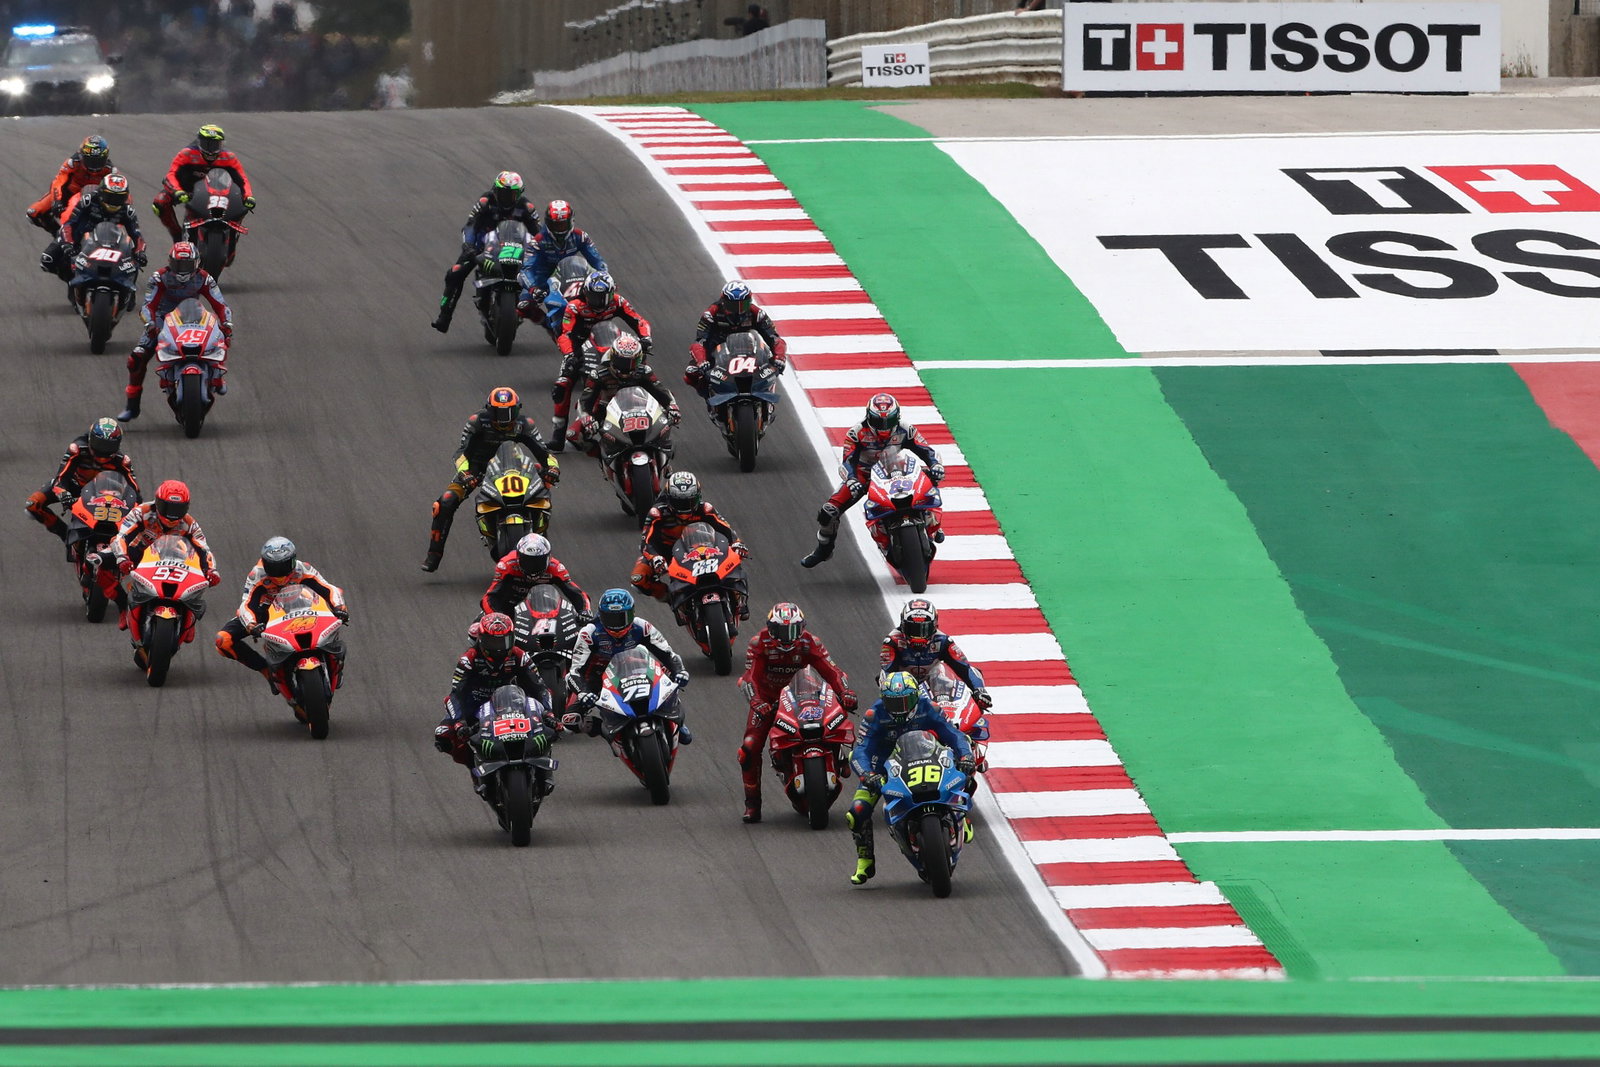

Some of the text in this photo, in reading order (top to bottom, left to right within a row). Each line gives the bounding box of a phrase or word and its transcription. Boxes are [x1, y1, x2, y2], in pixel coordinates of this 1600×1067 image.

[1193, 22, 1481, 72] TISSOT
[865, 64, 925, 76] TISSOT
[207, 195, 230, 210] 32
[88, 248, 123, 263] 40
[498, 246, 523, 260] 21
[175, 328, 209, 345] 49
[728, 356, 757, 375] 04
[622, 417, 649, 433] 30
[501, 476, 524, 495] 10
[94, 506, 122, 522] 33
[155, 559, 191, 571] REPSOL
[691, 558, 718, 578] 88
[134, 572, 154, 590] HONDA
[151, 566, 189, 583] 93
[187, 582, 208, 594] HONDA
[282, 610, 320, 621] REPSOL
[321, 621, 342, 639] HONDA
[264, 634, 288, 646] HONDA
[620, 678, 649, 689] CUSTOM
[622, 683, 651, 703] 73
[502, 712, 526, 720] ENEOS
[827, 714, 844, 730] Lenovo
[493, 719, 531, 737] 20
[776, 718, 797, 734] Lenovo
[498, 733, 529, 741] MONSTER
[907, 759, 933, 768] SUZUKI
[906, 764, 941, 788] 36
